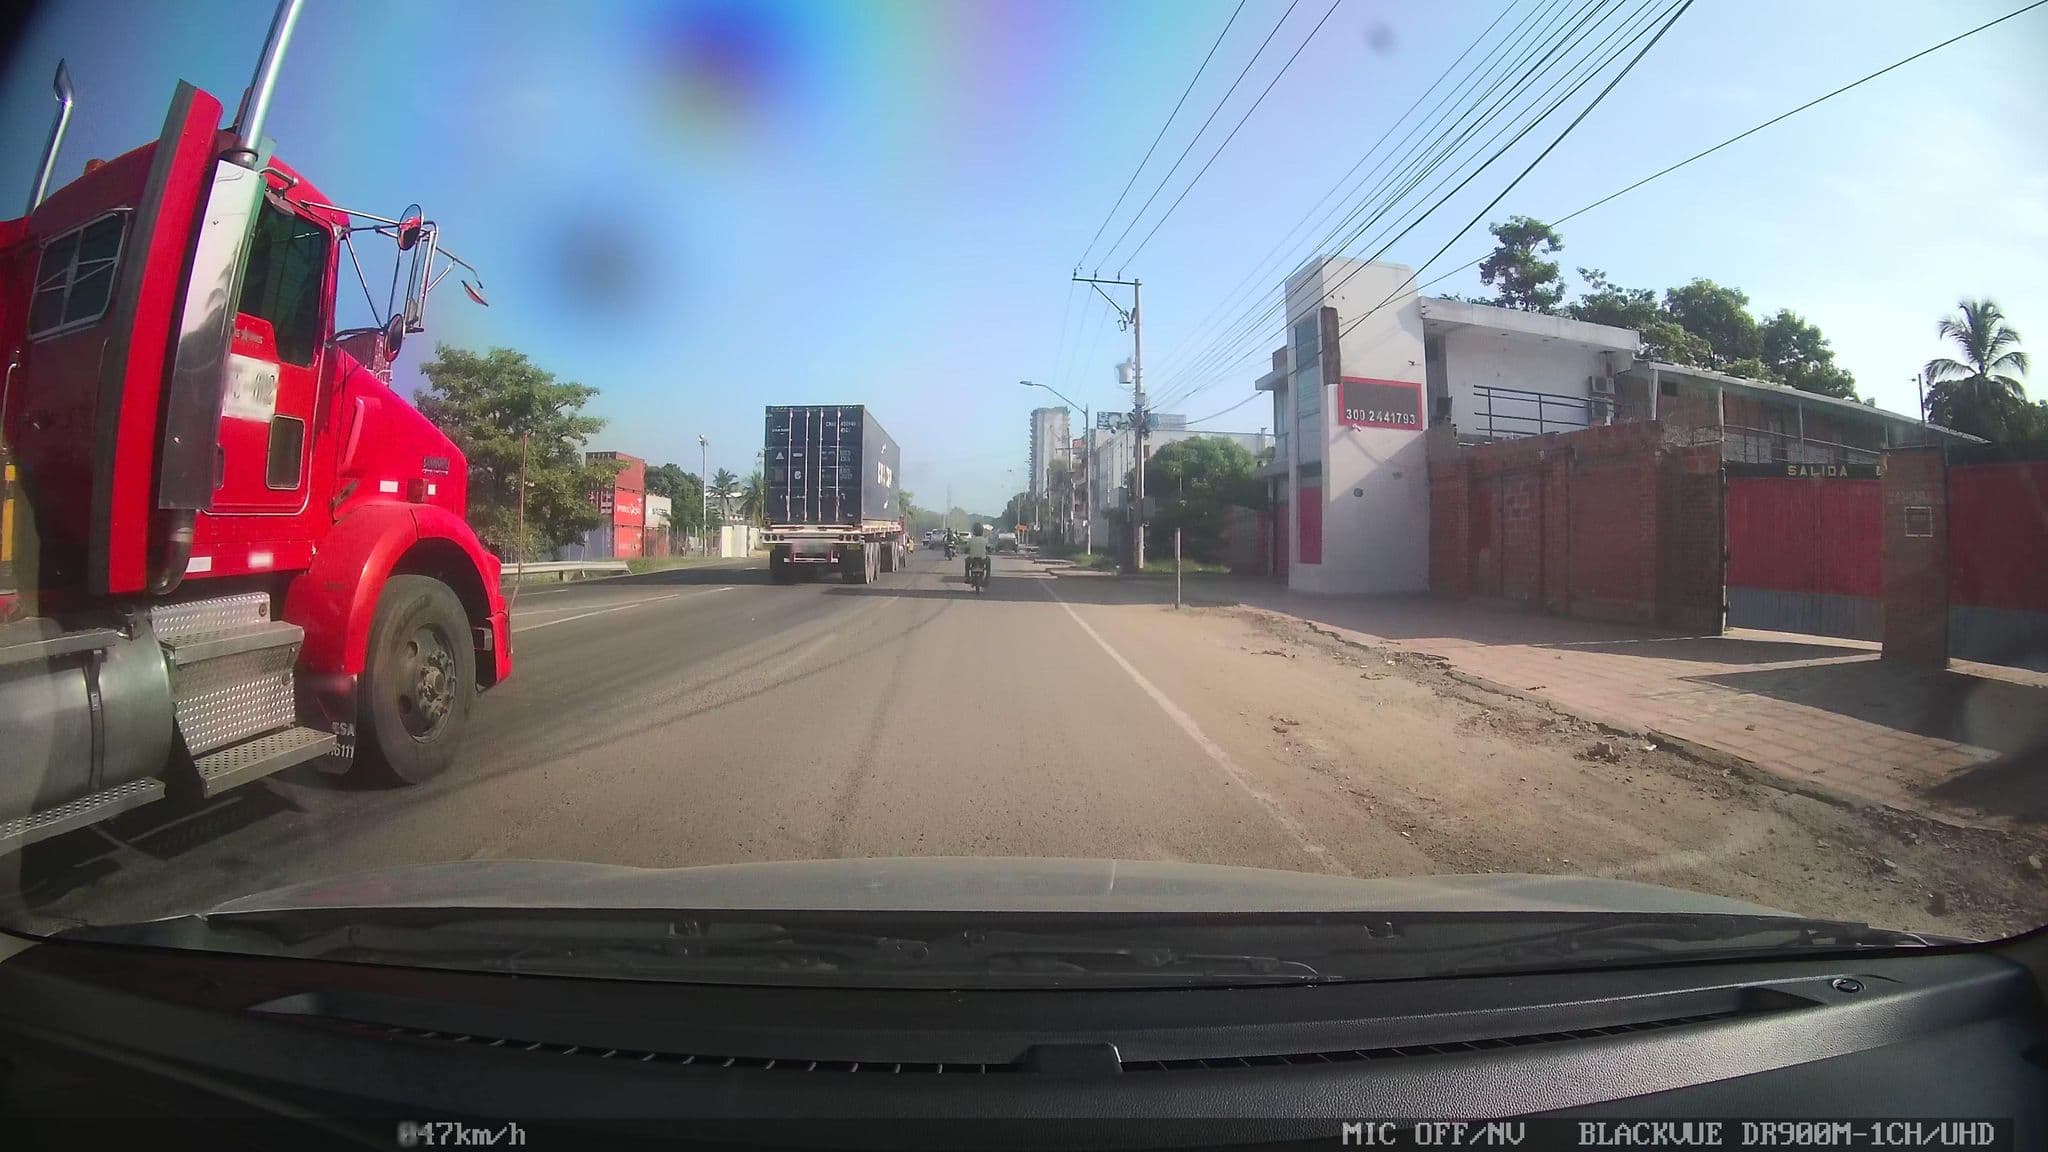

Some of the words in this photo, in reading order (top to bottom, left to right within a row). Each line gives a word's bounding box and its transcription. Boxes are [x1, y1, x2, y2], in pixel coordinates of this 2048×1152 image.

[1346, 408, 1365, 420] 300
[1368, 410, 1416, 425] 2441793
[1786, 465, 1848, 478] SALIDA
